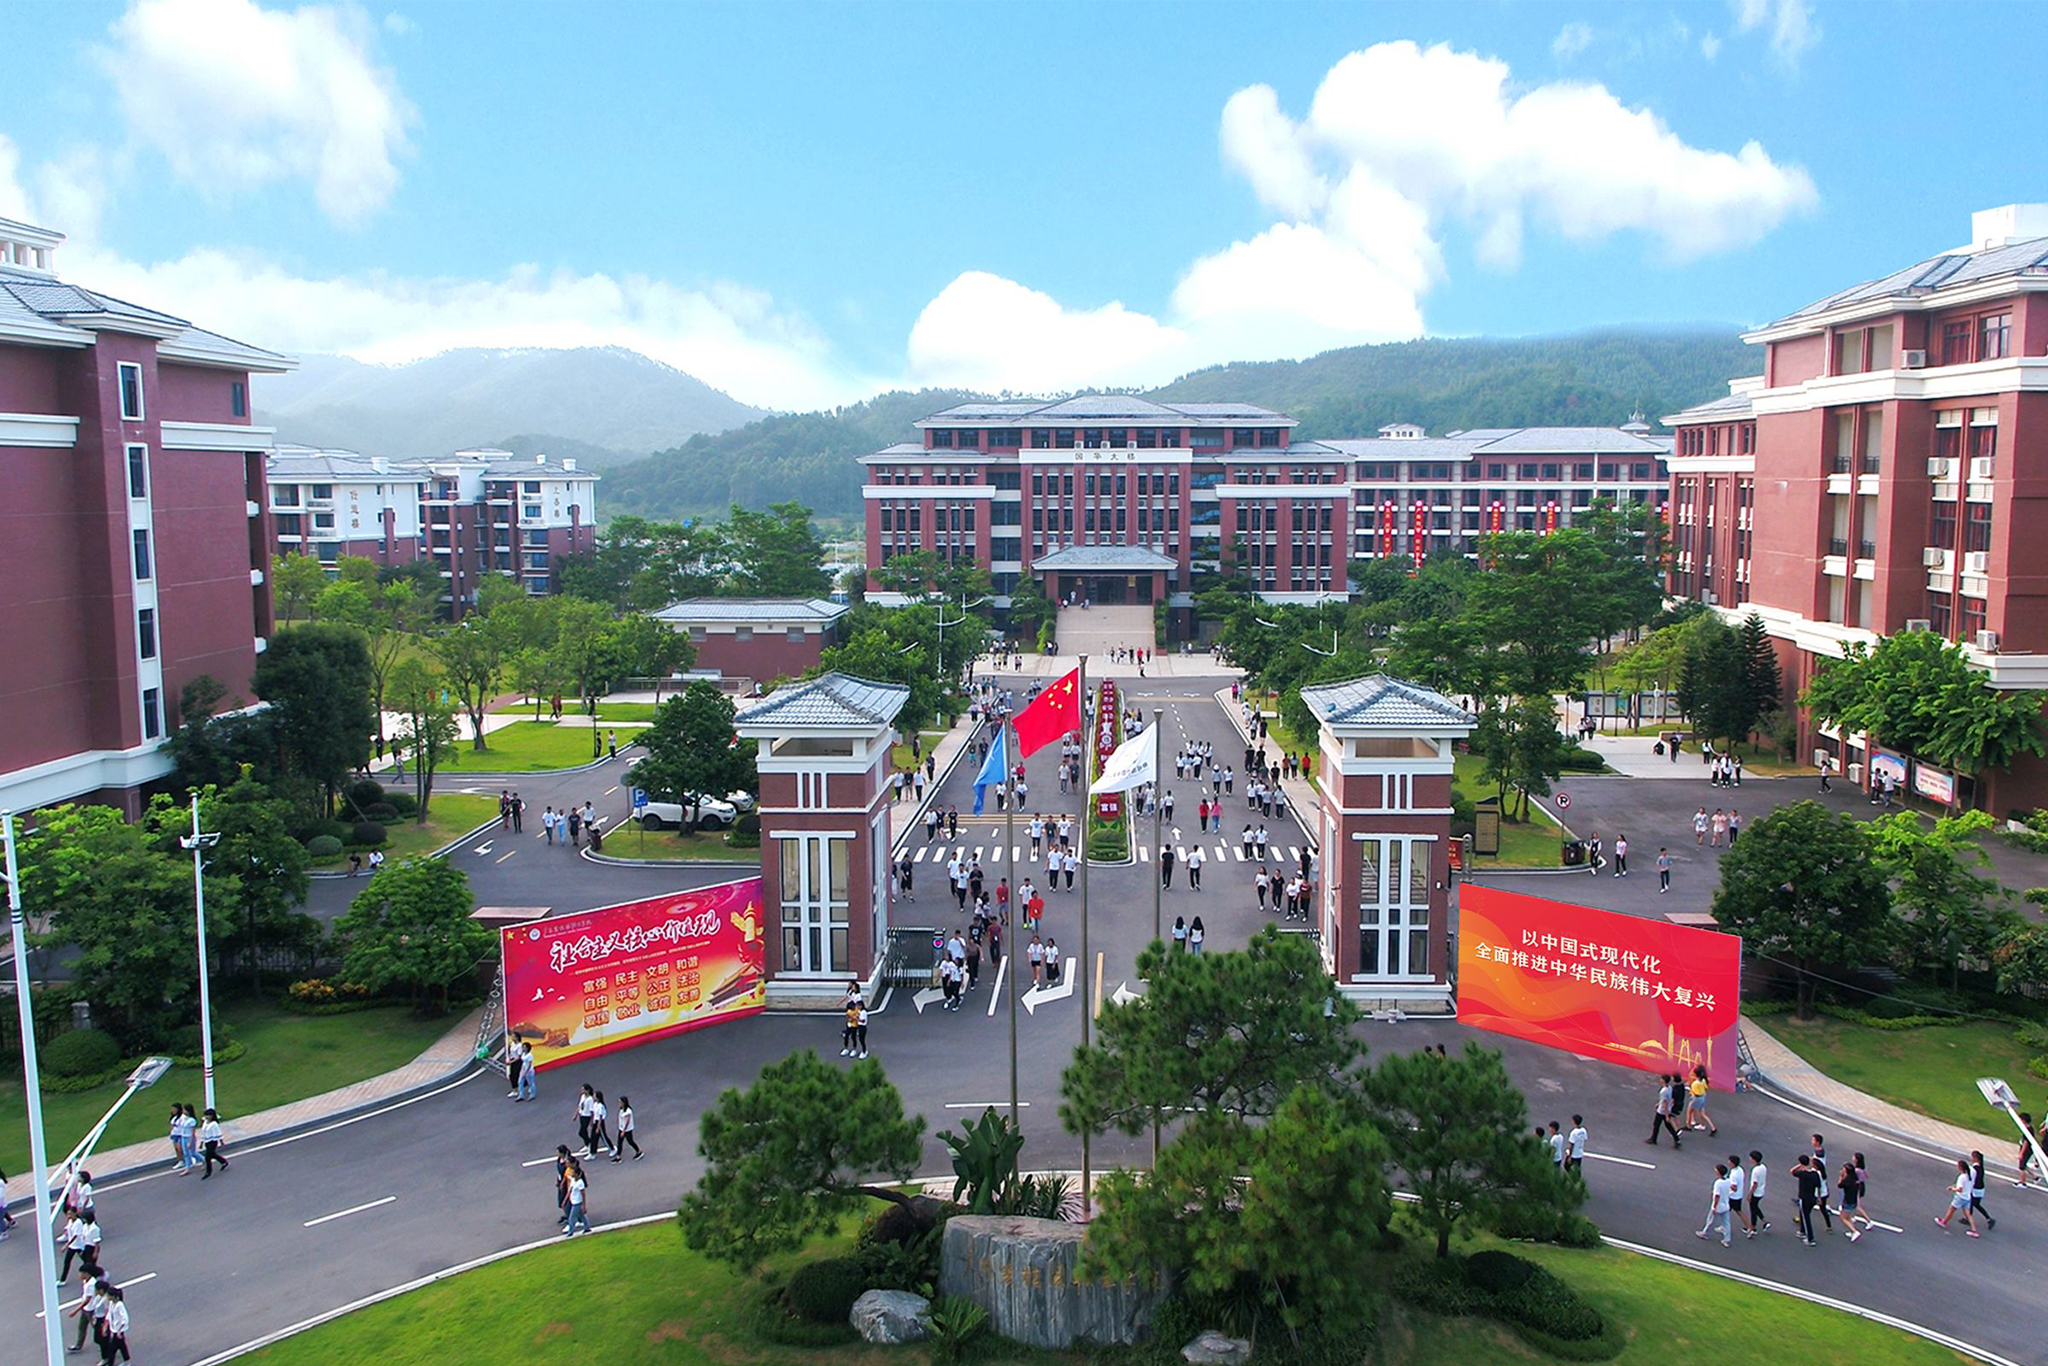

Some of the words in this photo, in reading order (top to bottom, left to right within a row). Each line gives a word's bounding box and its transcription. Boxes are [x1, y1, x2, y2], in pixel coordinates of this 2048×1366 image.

[635, 789, 645, 801] P
[1100, 803, 1117, 812] 富强
[1522, 929, 1661, 975] 以中国式现代化
[583, 976, 607, 993] 富强
[615, 970, 638, 985] 民主
[646, 962, 669, 978] 文明
[676, 956, 699, 971] 和谐
[584, 995, 608, 1011] 自由
[616, 986, 639, 1002] 平等
[647, 980, 670, 995] 公正
[677, 972, 699, 988] 法治
[1475, 942, 1716, 1011] 全面推进中华民族伟大复兴
[584, 1011, 609, 1028] 爱国
[616, 1003, 641, 1019] 敬业
[647, 995, 671, 1011] 诚信
[677, 988, 700, 1004] 友善
